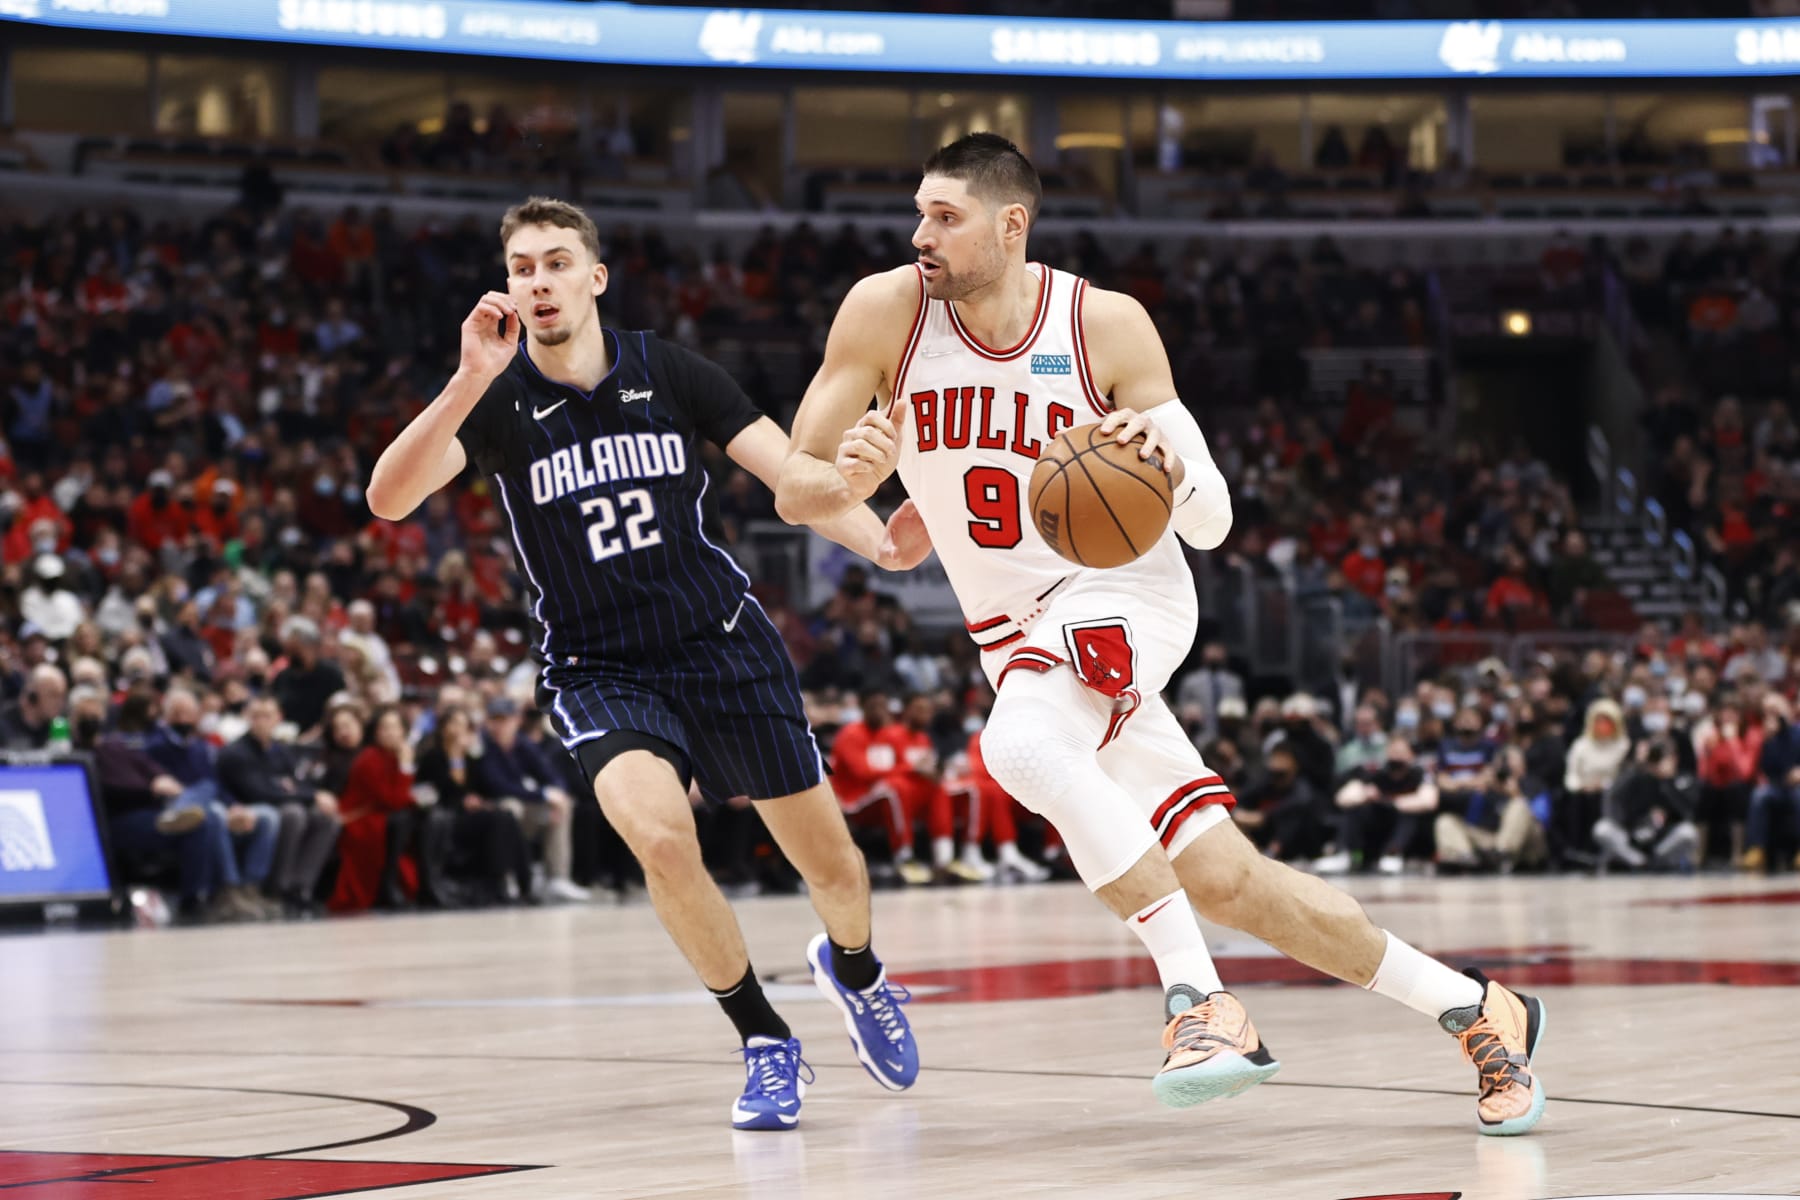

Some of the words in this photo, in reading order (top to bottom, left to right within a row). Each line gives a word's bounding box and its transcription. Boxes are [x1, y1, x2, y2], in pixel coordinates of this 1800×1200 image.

[279, 0, 446, 38] SAMSUNG
[991, 29, 1160, 65] SAMSUNG
[1031, 356, 1070, 366] ZENNI
[618, 388, 653, 403] Disney
[529, 432, 686, 506] ORLANDO
[579, 488, 663, 564] 22
[963, 465, 1023, 549] 9
